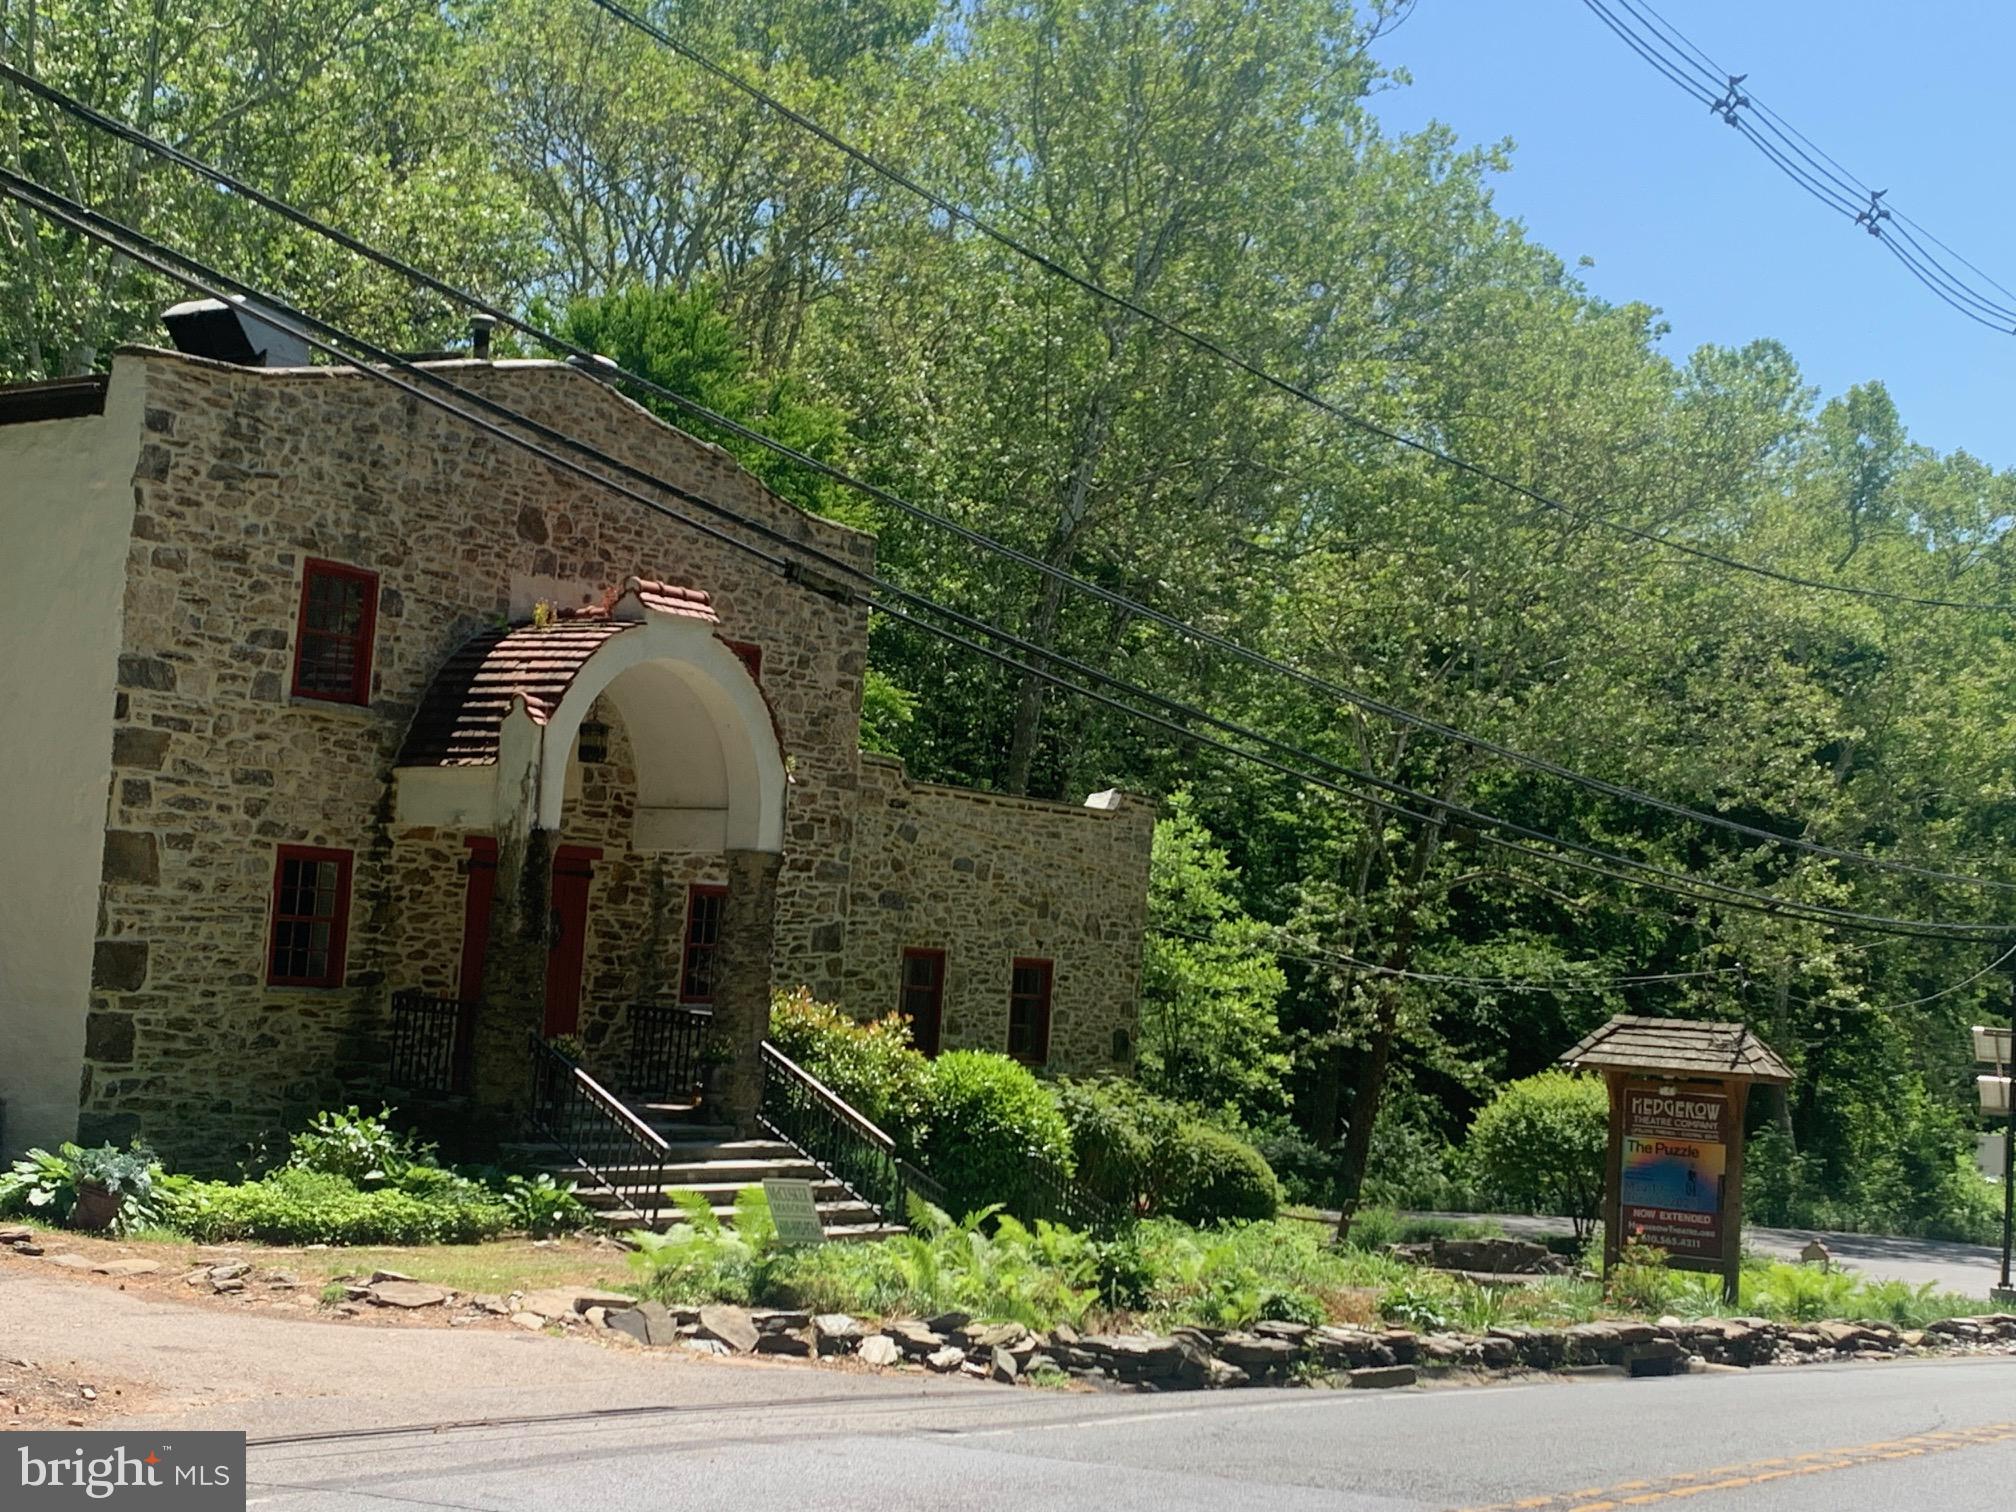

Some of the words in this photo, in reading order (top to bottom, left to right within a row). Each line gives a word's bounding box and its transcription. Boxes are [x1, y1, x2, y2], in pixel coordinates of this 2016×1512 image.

[1631, 1097, 1720, 1121] HEDGEROW
[1633, 1115, 1672, 1126] THEATRE
[1674, 1118, 1719, 1130] COMPANY
[1627, 1139, 1653, 1153] The
[1655, 1142, 1700, 1158] Puzzle
[1632, 1208, 1656, 1219] NOW
[1659, 1211, 1711, 1224] EXTENDED
